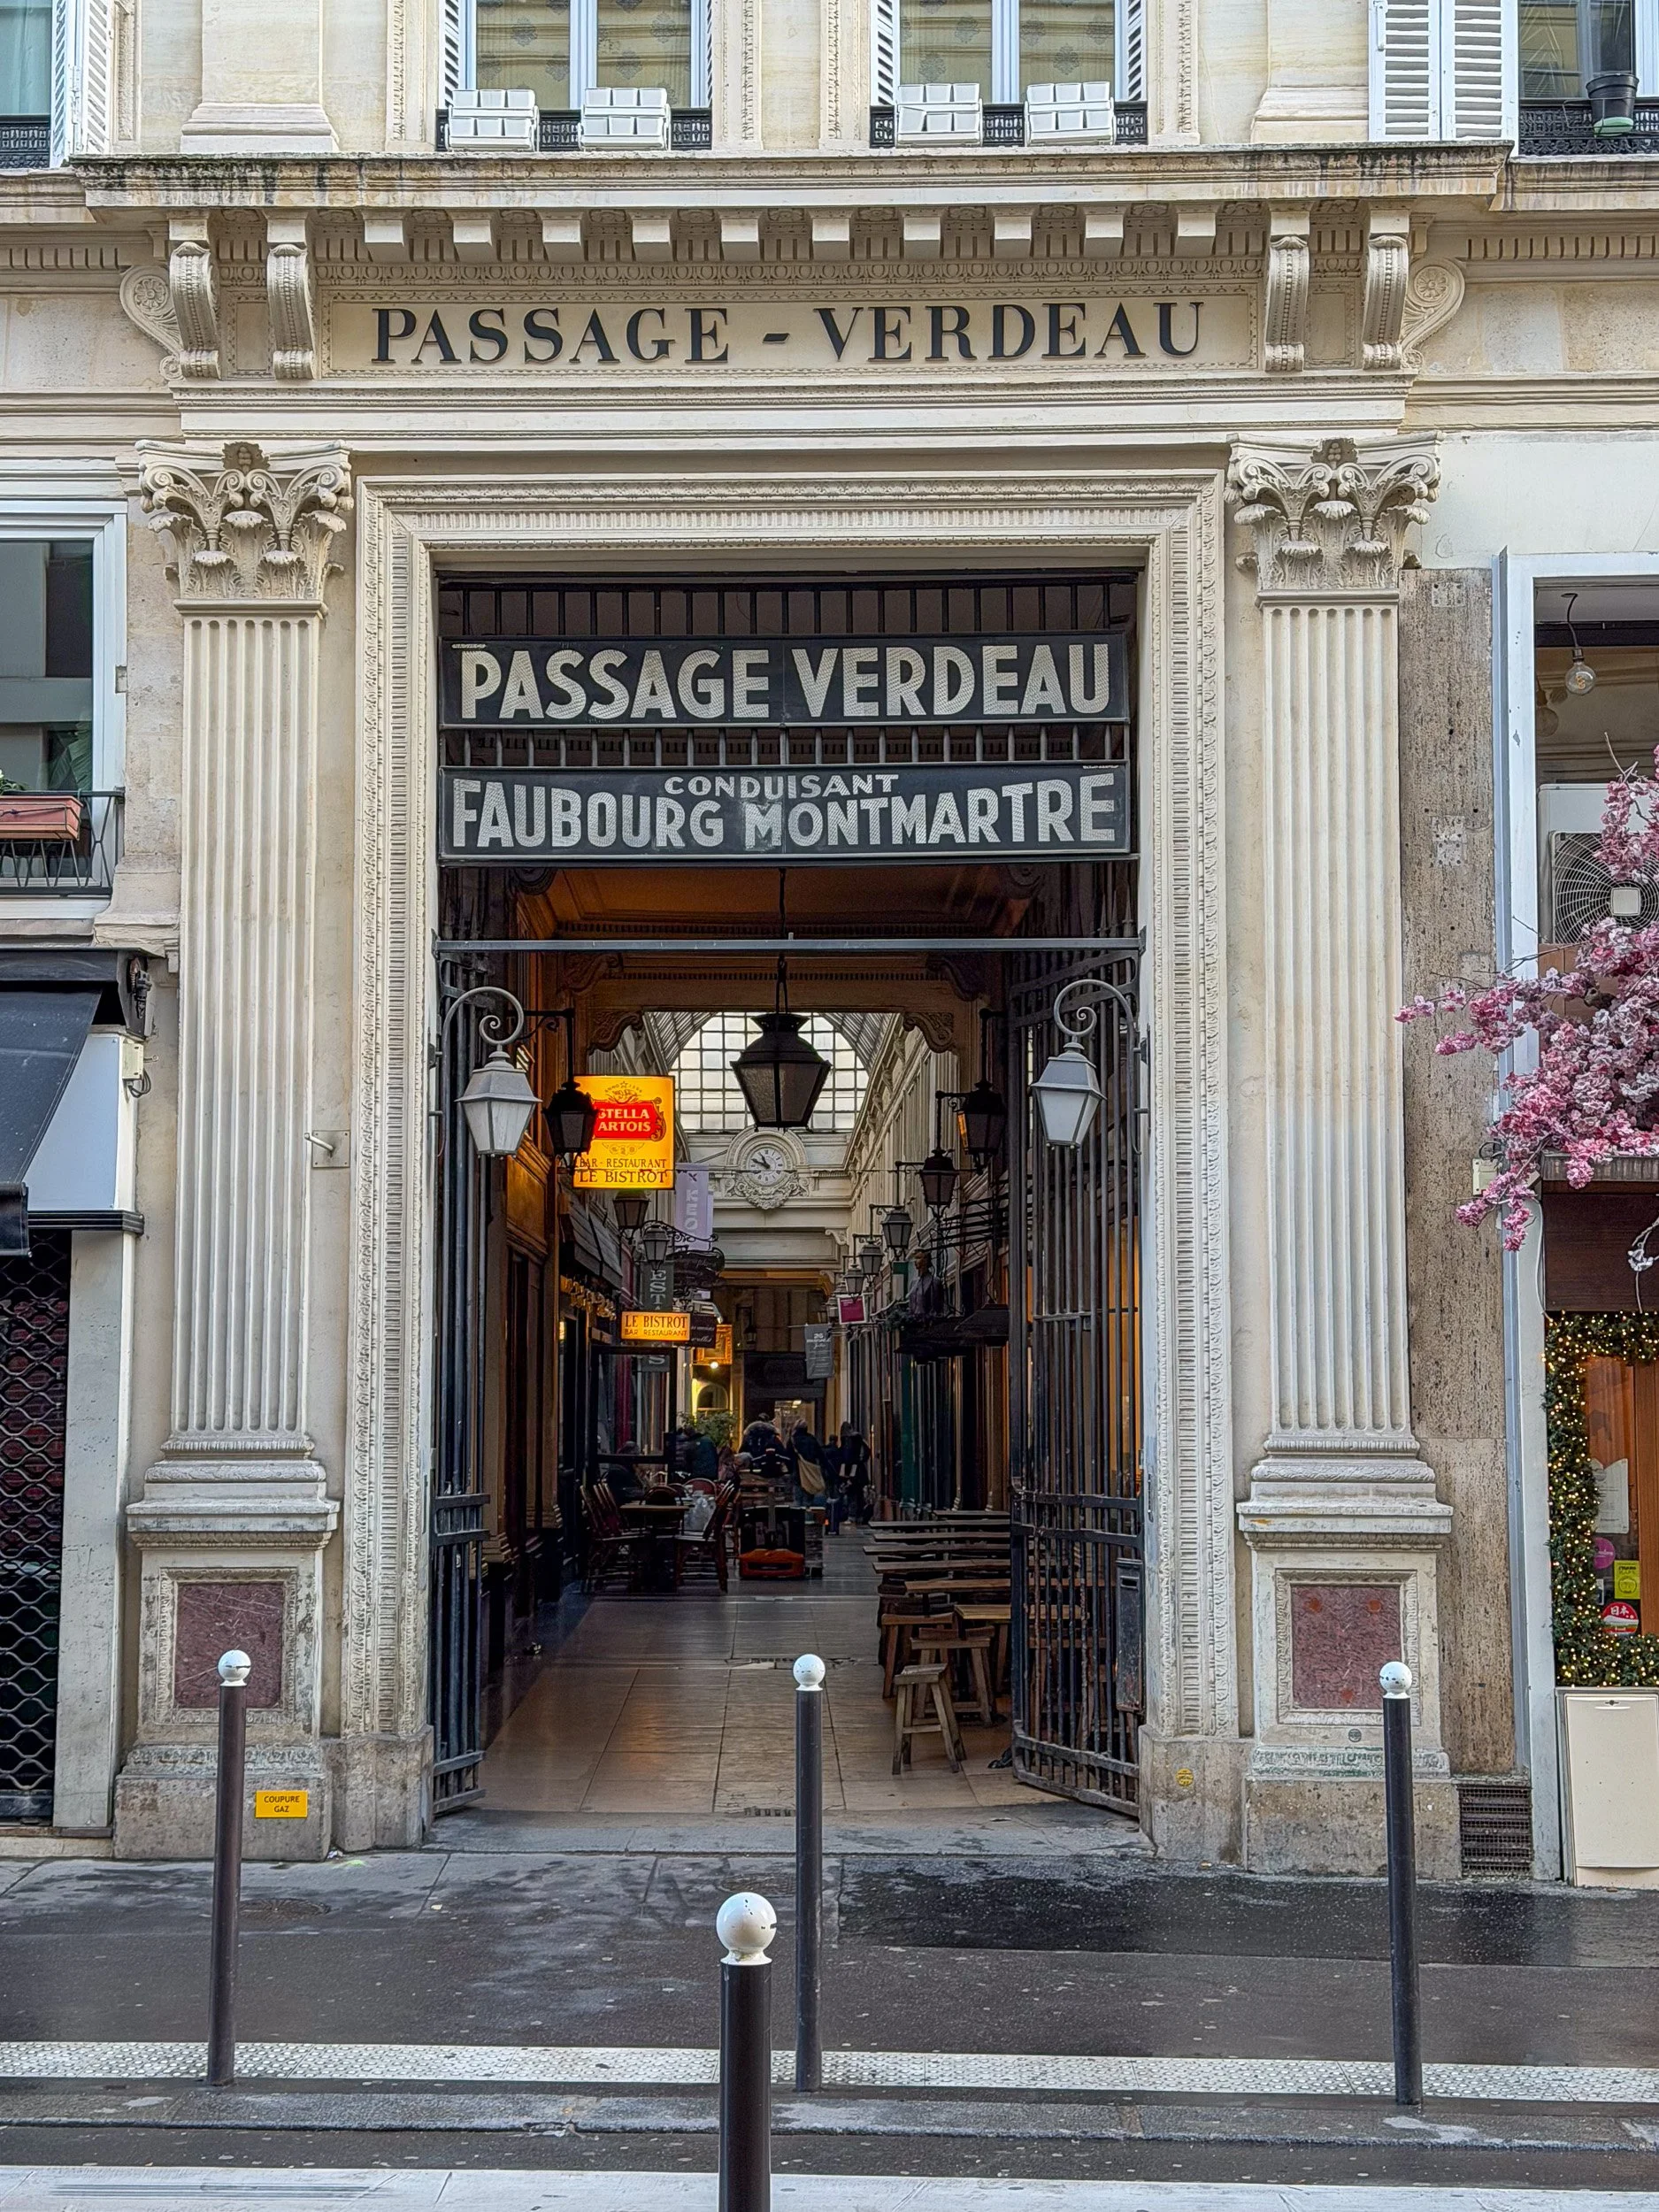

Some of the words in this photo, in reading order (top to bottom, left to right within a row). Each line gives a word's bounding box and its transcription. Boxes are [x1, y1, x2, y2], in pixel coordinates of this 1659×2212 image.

[371, 307, 730, 365] PASSAGE
[813, 302, 1204, 362] VERDEAU
[461, 649, 771, 720] PASSAGE
[792, 641, 1110, 718] VERDEAU
[664, 772, 899, 800] CONDUISANT
[452, 777, 726, 849] FAUBOURG
[743, 772, 1116, 849] MONTMARTRE
[598, 1108, 650, 1119] STELLA
[597, 1121, 652, 1132] ARTOIS
[580, 1158, 598, 1168] BAR
[606, 1158, 667, 1169] RESTAURANT
[579, 1171, 598, 1183] LE
[604, 1171, 668, 1184] BISTROT
[625, 1315, 638, 1327] LE
[643, 1316, 688, 1329] BISTROT
[643, 1328, 687, 1337] RESTAURANT
